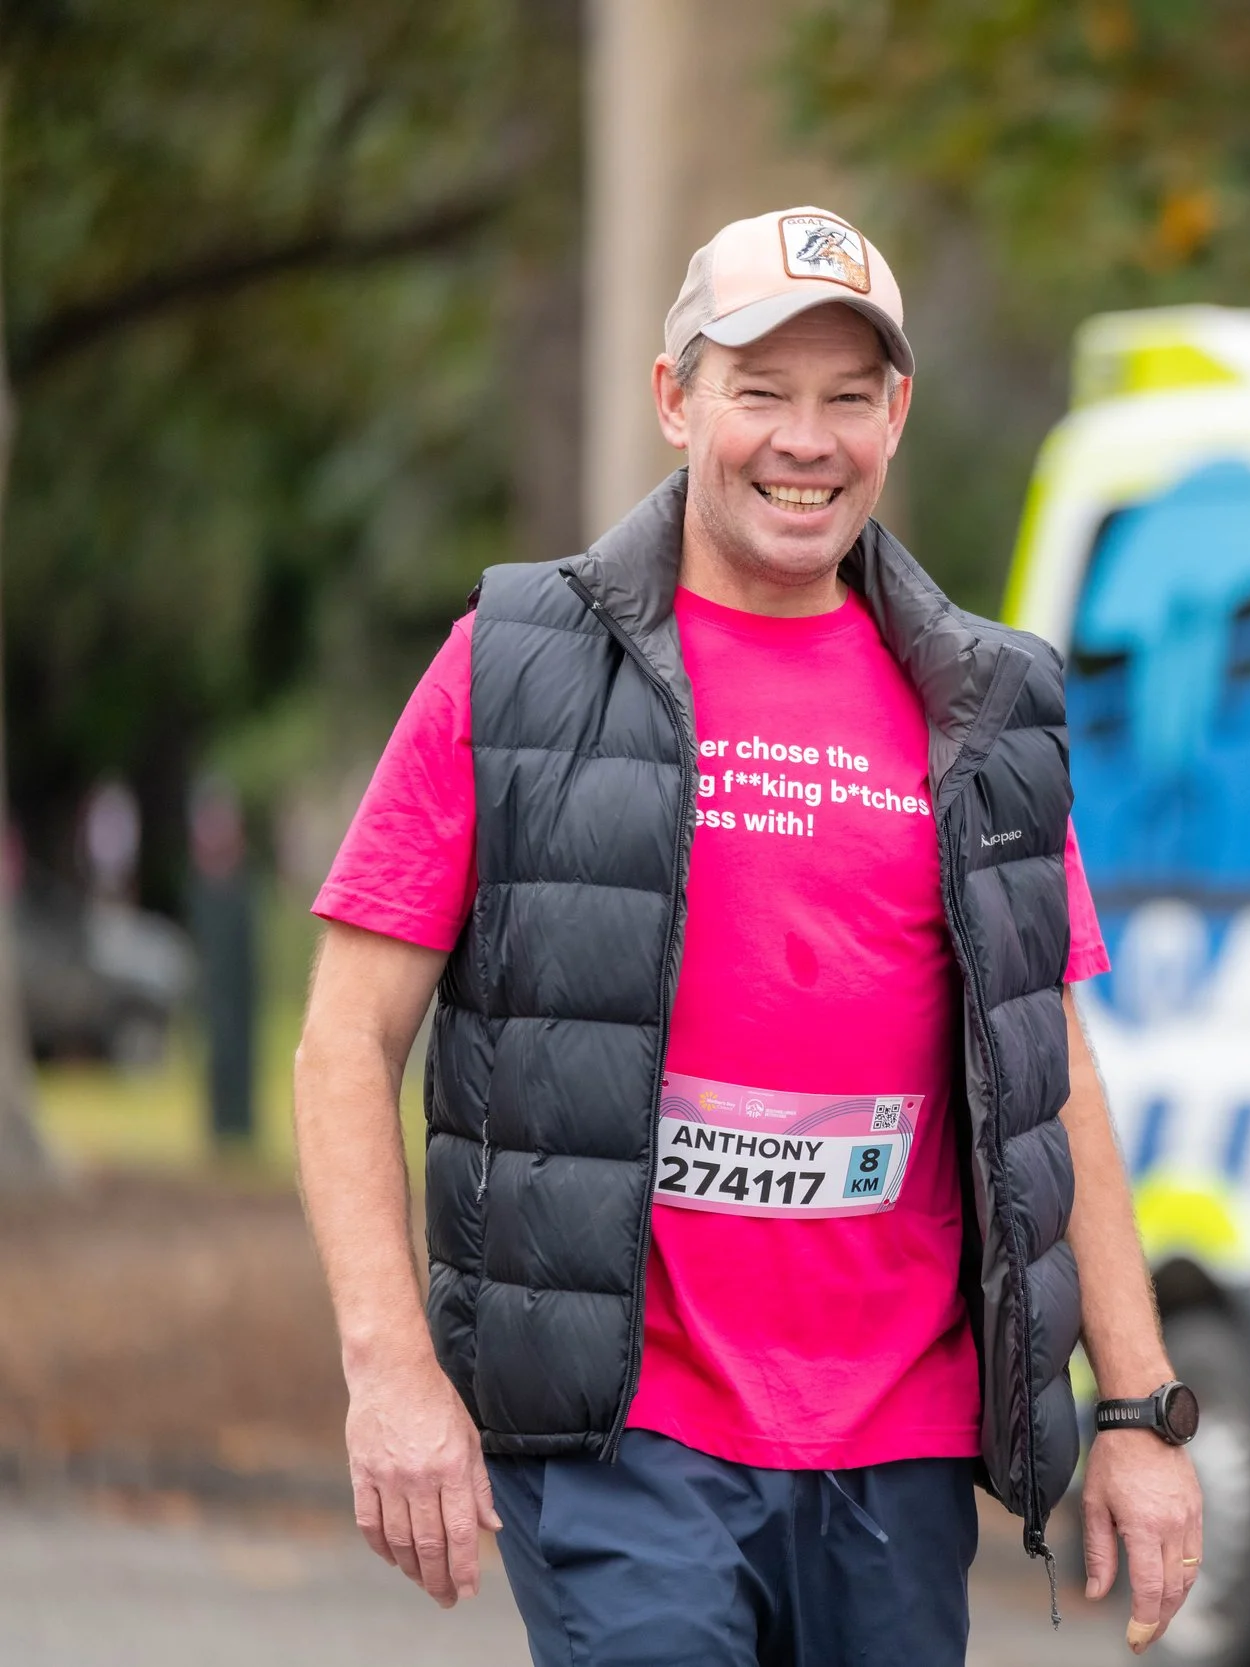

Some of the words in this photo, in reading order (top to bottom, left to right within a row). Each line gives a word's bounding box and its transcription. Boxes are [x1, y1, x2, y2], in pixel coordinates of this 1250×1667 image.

[735, 736, 820, 765] chose
[826, 746, 869, 772] the
[743, 809, 814, 837] with!
[671, 1125, 824, 1161] ANTHONY
[859, 1148, 881, 1173] 8
[658, 1156, 826, 1205] 274117
[851, 1177, 879, 1193] KM
